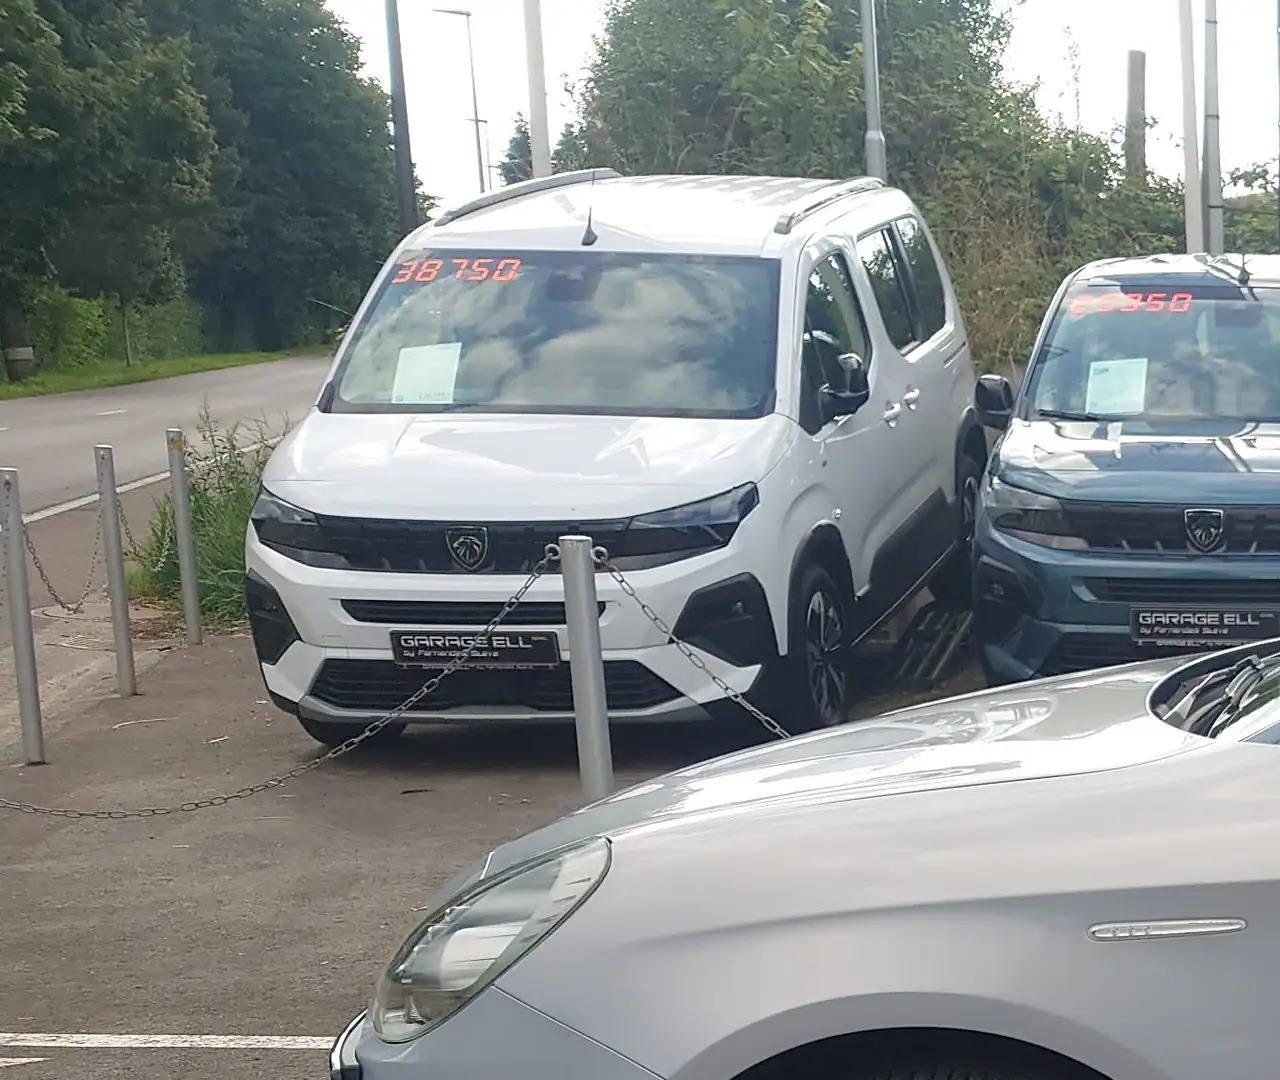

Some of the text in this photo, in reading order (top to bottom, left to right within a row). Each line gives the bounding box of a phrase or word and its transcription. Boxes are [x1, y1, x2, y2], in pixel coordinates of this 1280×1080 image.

[1138, 612, 1260, 626] GARAGE ELL
[400, 636, 532, 649] GARAGE ELL
